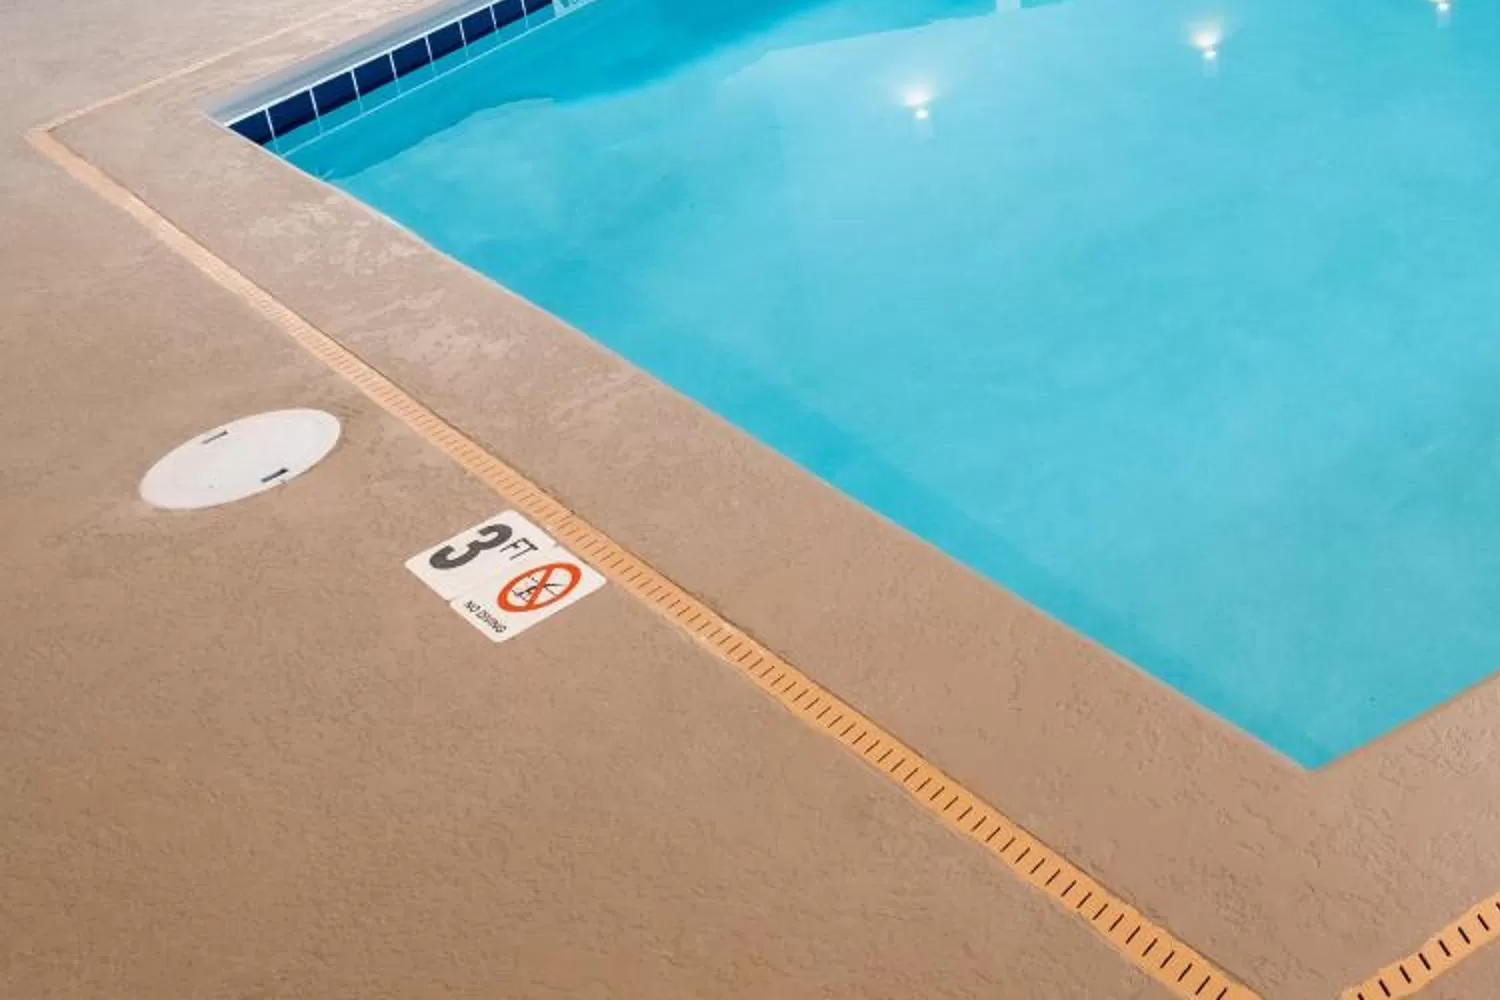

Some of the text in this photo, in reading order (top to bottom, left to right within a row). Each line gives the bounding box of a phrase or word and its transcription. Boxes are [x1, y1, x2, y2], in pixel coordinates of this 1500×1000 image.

[429, 523, 539, 570] 3 FT
[463, 600, 481, 613] NO
